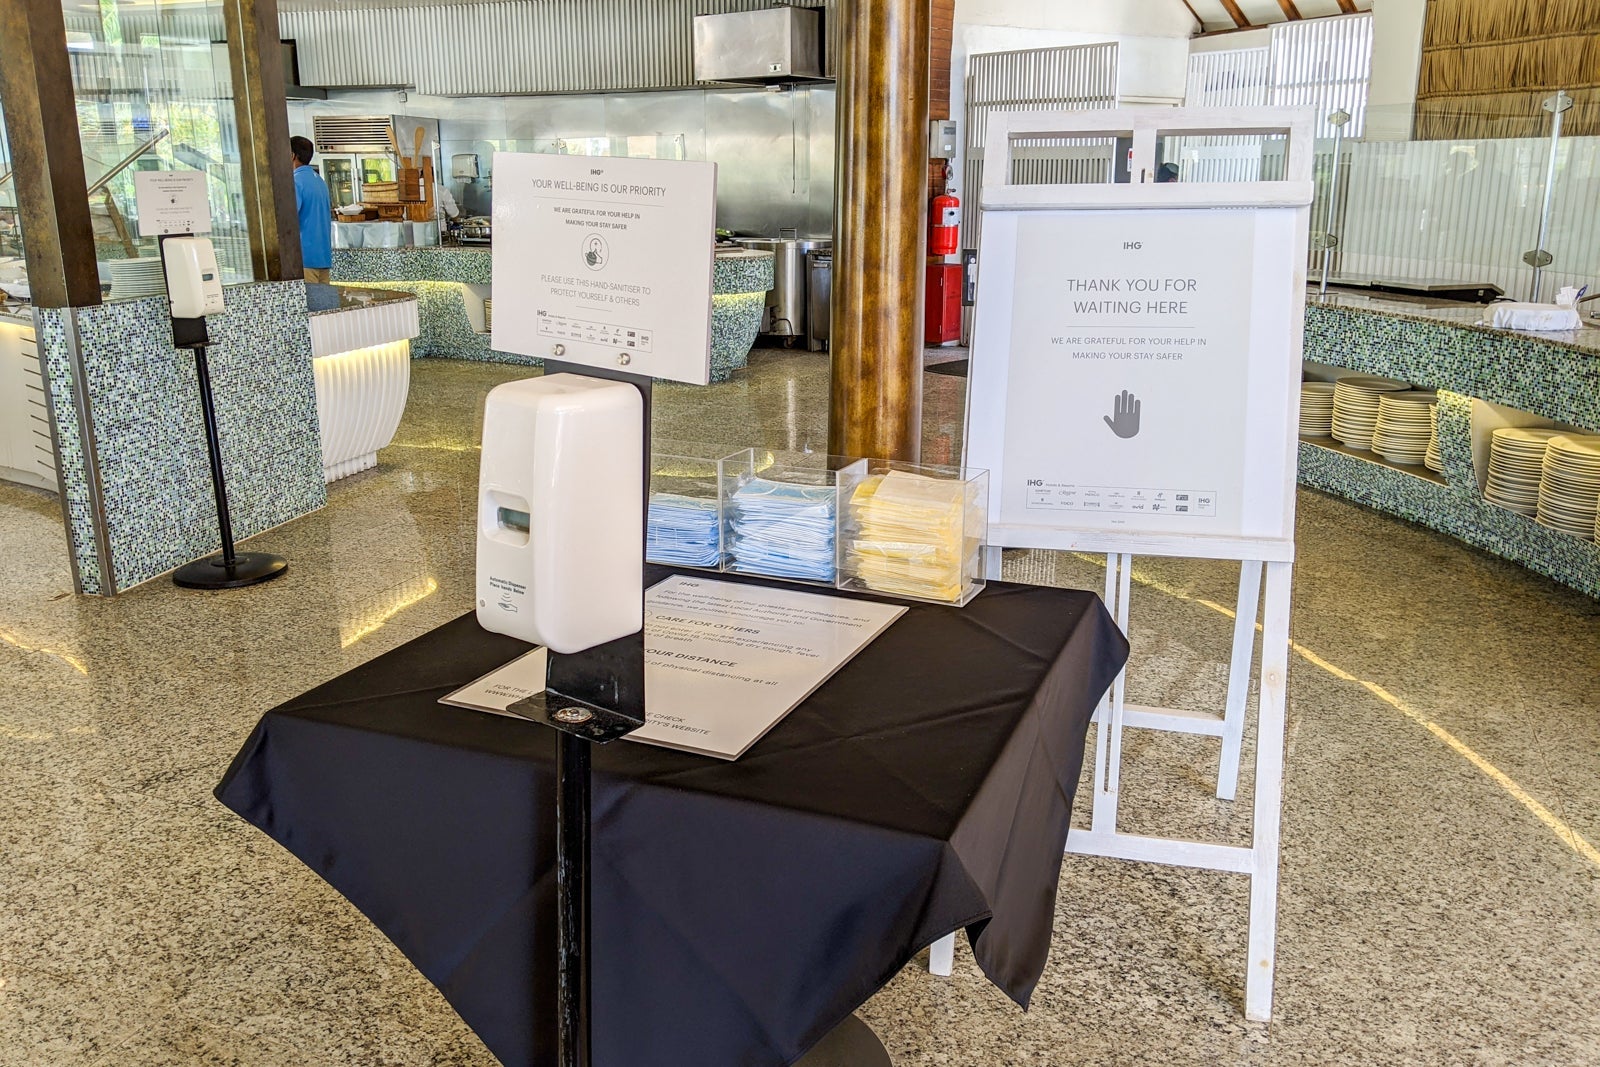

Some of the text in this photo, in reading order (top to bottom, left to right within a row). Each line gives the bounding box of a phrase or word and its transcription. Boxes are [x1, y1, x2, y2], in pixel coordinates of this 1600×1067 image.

[531, 178, 667, 197] YOUR WELL-BEING IS OUR PRIORITY
[571, 207, 596, 216] GRATEFUL
[565, 218, 585, 227] MAKING
[585, 220, 599, 228] YOUR
[599, 221, 611, 229] STAY
[540, 274, 651, 295] PLEASE USE THIS HAND-SANITISER TO
[1067, 279, 1197, 292] THANK YOU FOR
[550, 288, 577, 298] PROTECT
[578, 291, 608, 302] YOURSELF
[615, 296, 640, 307] OTHERS
[1073, 301, 1188, 314] WAITING HERE
[1051, 337, 1064, 345] WE
[1066, 337, 1082, 345] ARE
[1084, 337, 1127, 345] GRATEFUL
[1174, 338, 1196, 346] HELP
[1197, 338, 1207, 346] IN
[1072, 352, 1106, 360] MAKING
[1108, 352, 1132, 360] YOUR
[1133, 352, 1154, 360] STAY
[656, 615, 688, 623] CARE
[714, 624, 760, 635] OTHERS
[645, 648, 738, 668] OUR DISTANCE
[662, 662, 702, 673] physical
[702, 668, 751, 682] distancing
[654, 714, 686, 723] CHECK
[672, 724, 712, 736] WEBSITE
